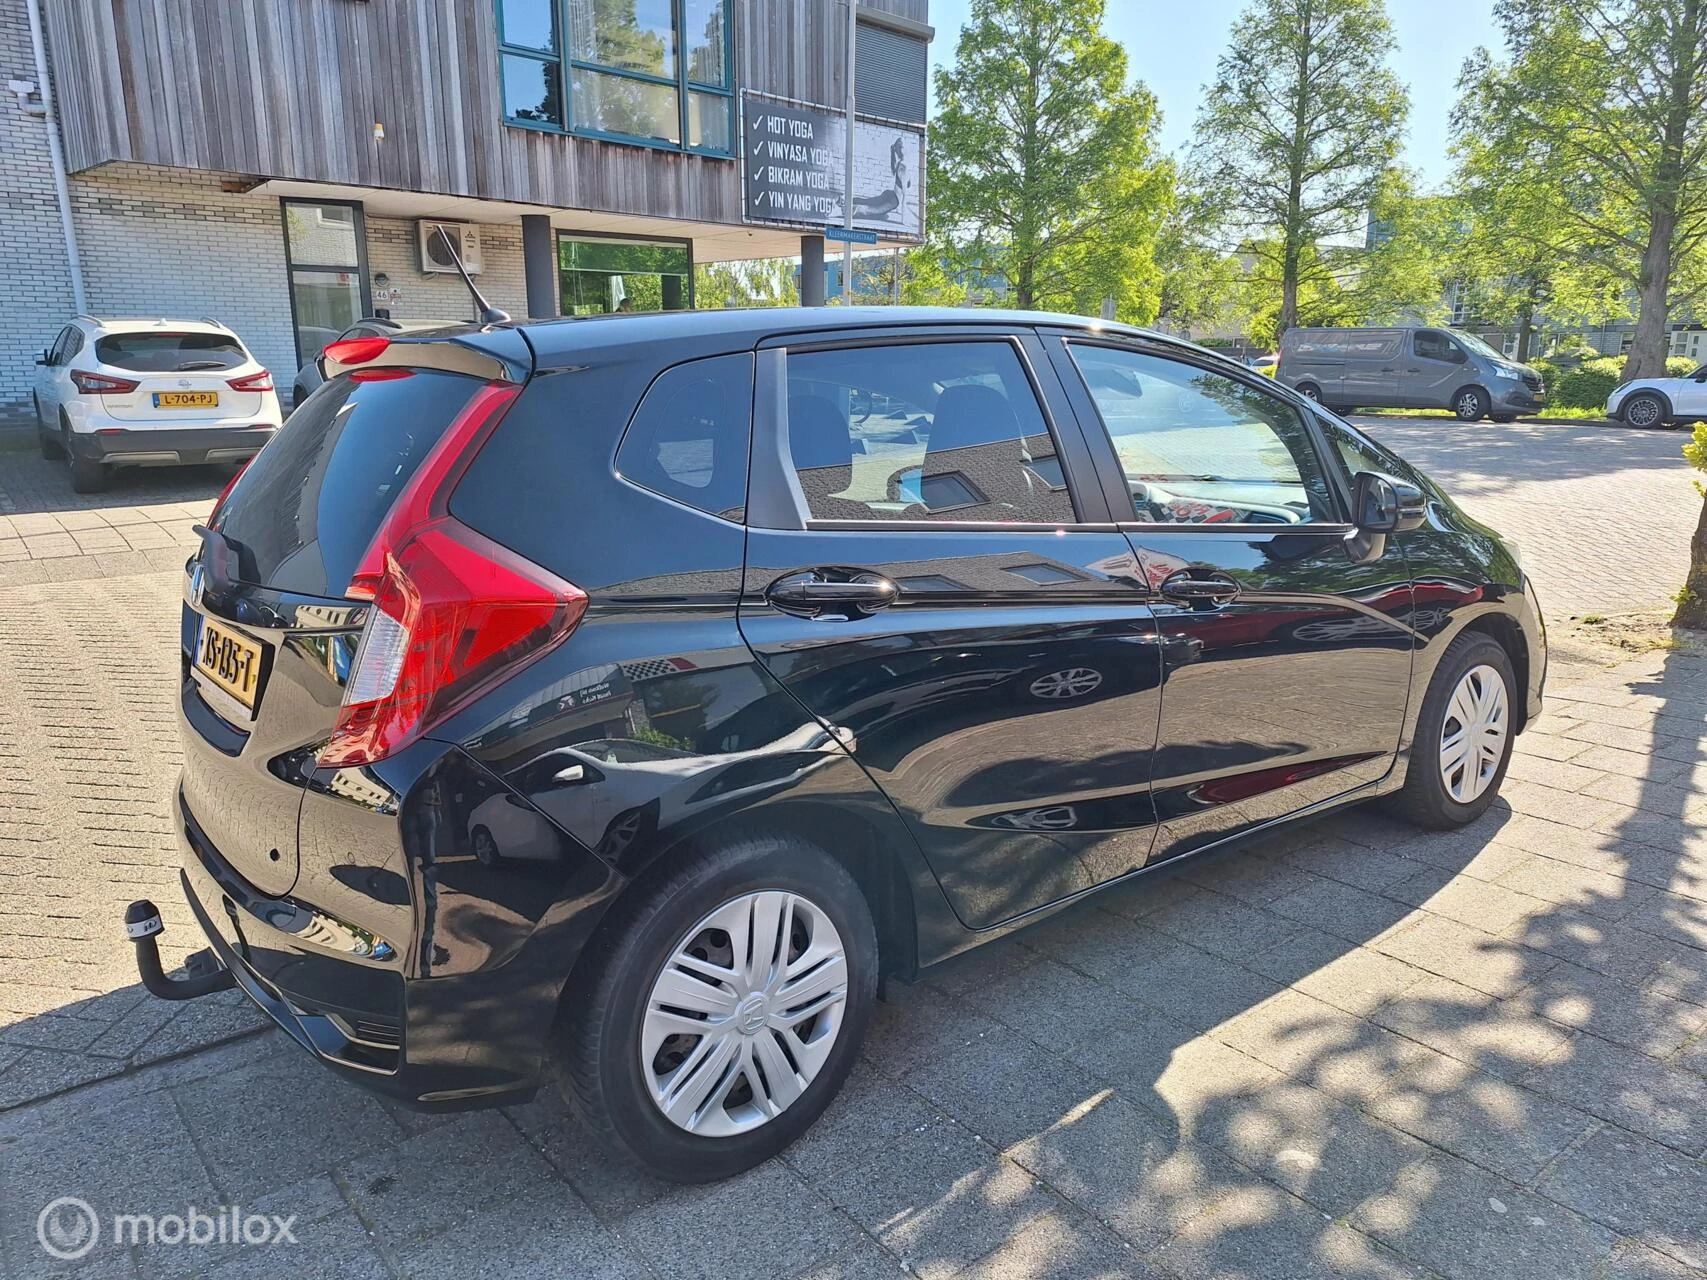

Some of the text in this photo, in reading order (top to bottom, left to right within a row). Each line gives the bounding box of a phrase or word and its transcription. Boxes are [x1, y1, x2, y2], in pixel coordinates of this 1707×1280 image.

[767, 115, 813, 140] HOT YOGA
[767, 141, 833, 166] VINYASA YOGA
[768, 166, 830, 190] BIKRAM YOGA
[768, 191, 837, 214] YIN YANG YOGA
[377, 291, 387, 299] 46
[164, 394, 212, 404] L-704-PJ
